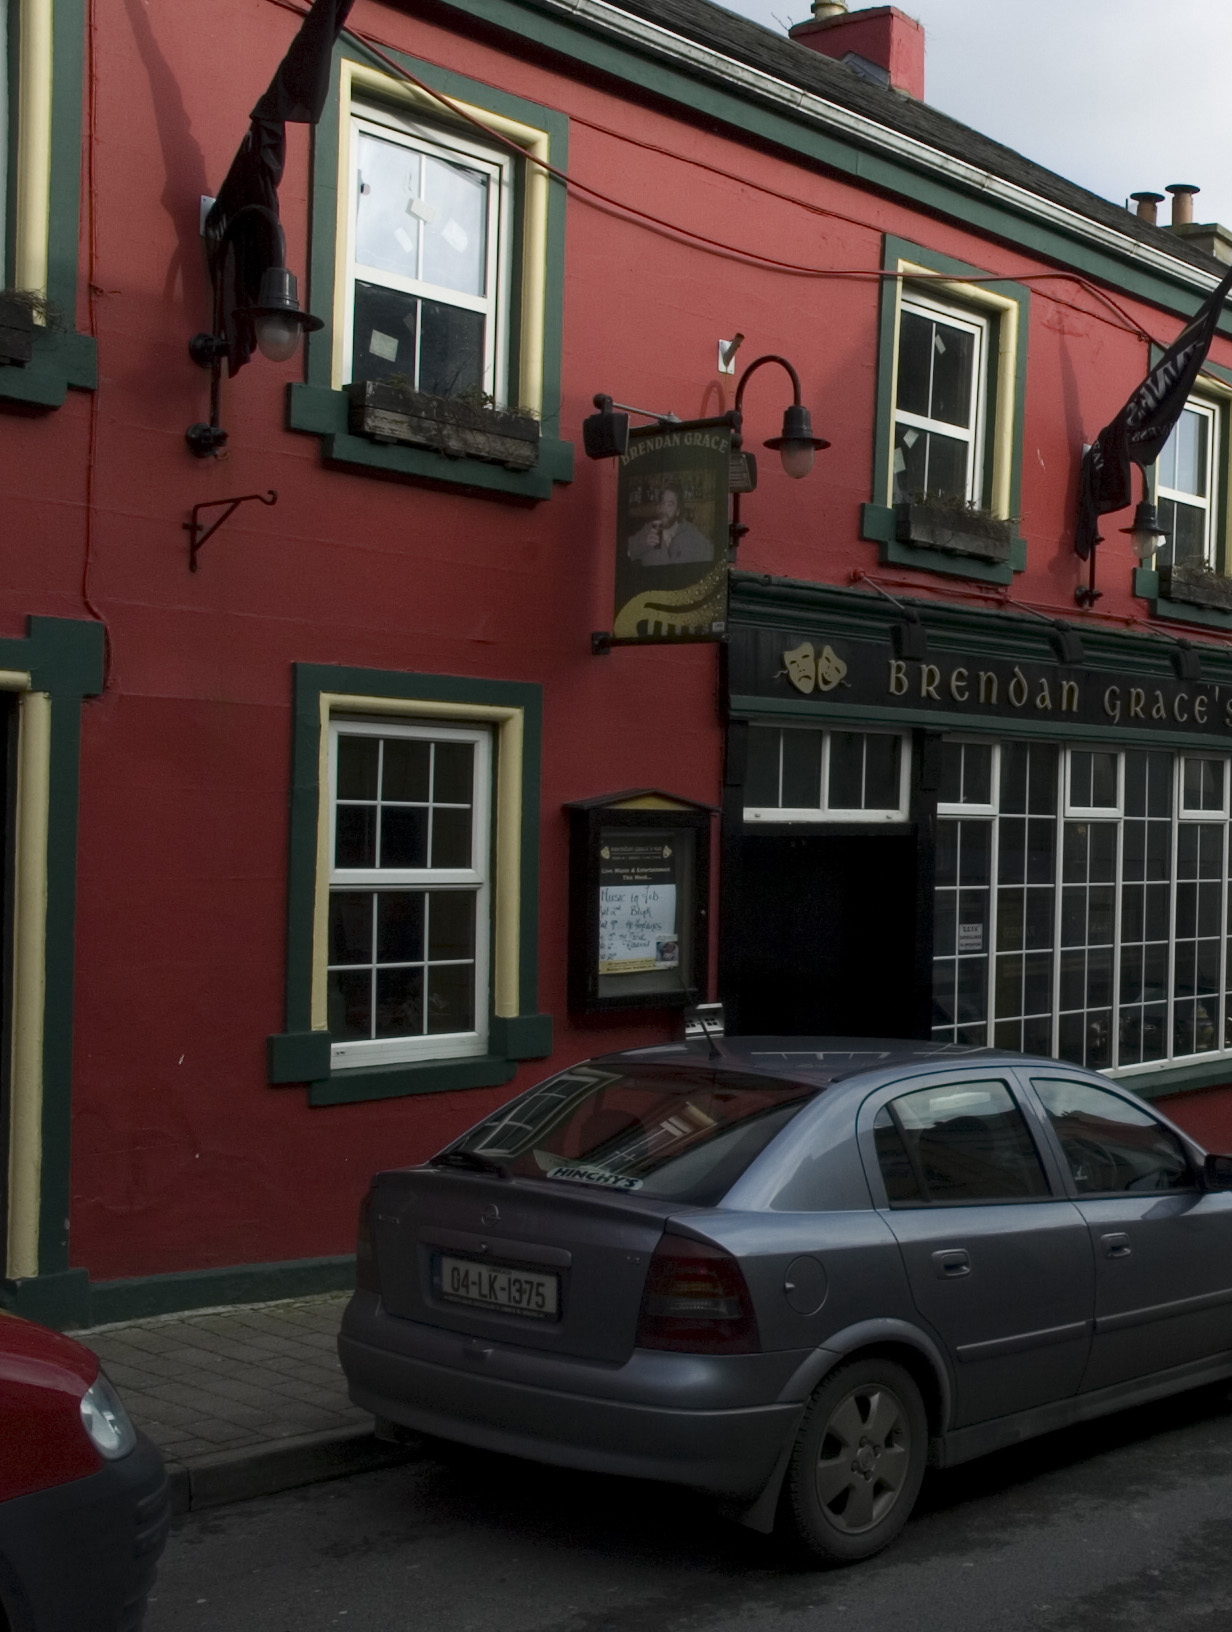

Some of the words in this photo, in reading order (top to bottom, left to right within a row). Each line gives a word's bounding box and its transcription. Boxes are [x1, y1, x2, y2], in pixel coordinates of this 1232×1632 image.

[620, 432, 681, 466] BRENDAN
[683, 432, 729, 454] GRACE
[553, 1167, 639, 1188] HINCHY'S
[450, 1266, 547, 1309] 04-LK-1375
